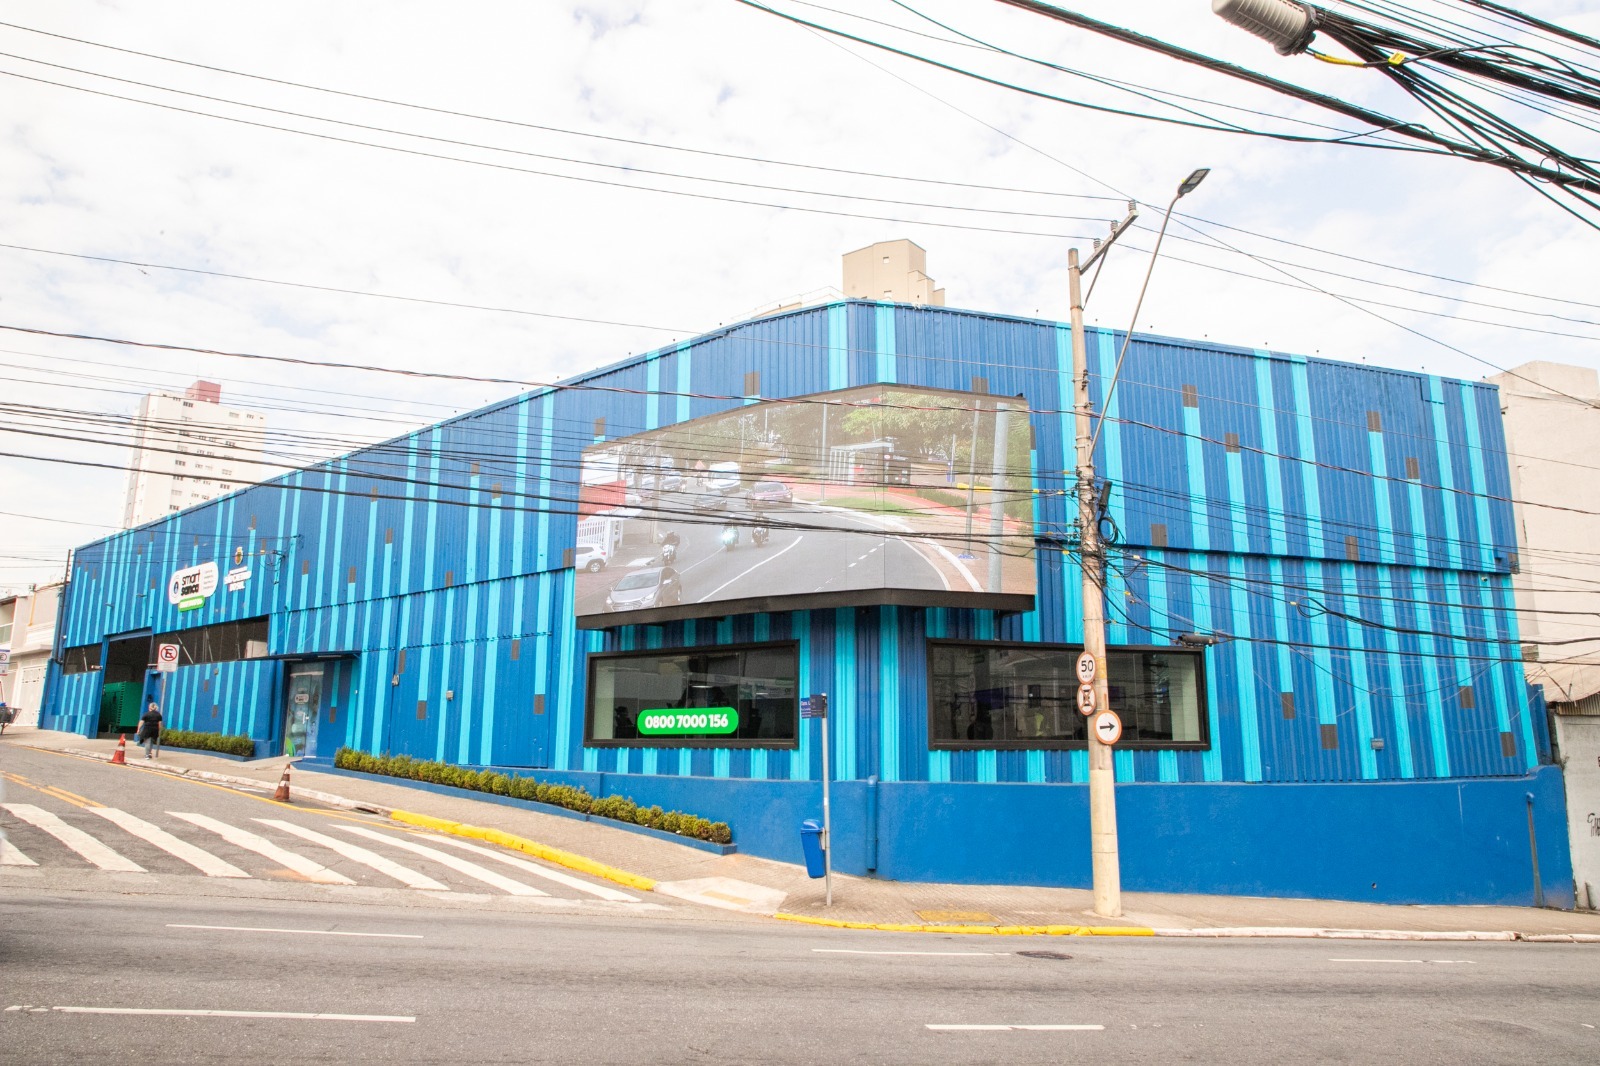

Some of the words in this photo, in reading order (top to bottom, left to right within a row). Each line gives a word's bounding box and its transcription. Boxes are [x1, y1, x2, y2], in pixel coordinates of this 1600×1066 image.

[182, 569, 200, 586] smart
[181, 584, 199, 596] sanca
[1081, 660, 1093, 672] 50
[645, 715, 675, 728] 0800
[676, 714, 707, 728] 7000
[709, 714, 728, 728] 156
